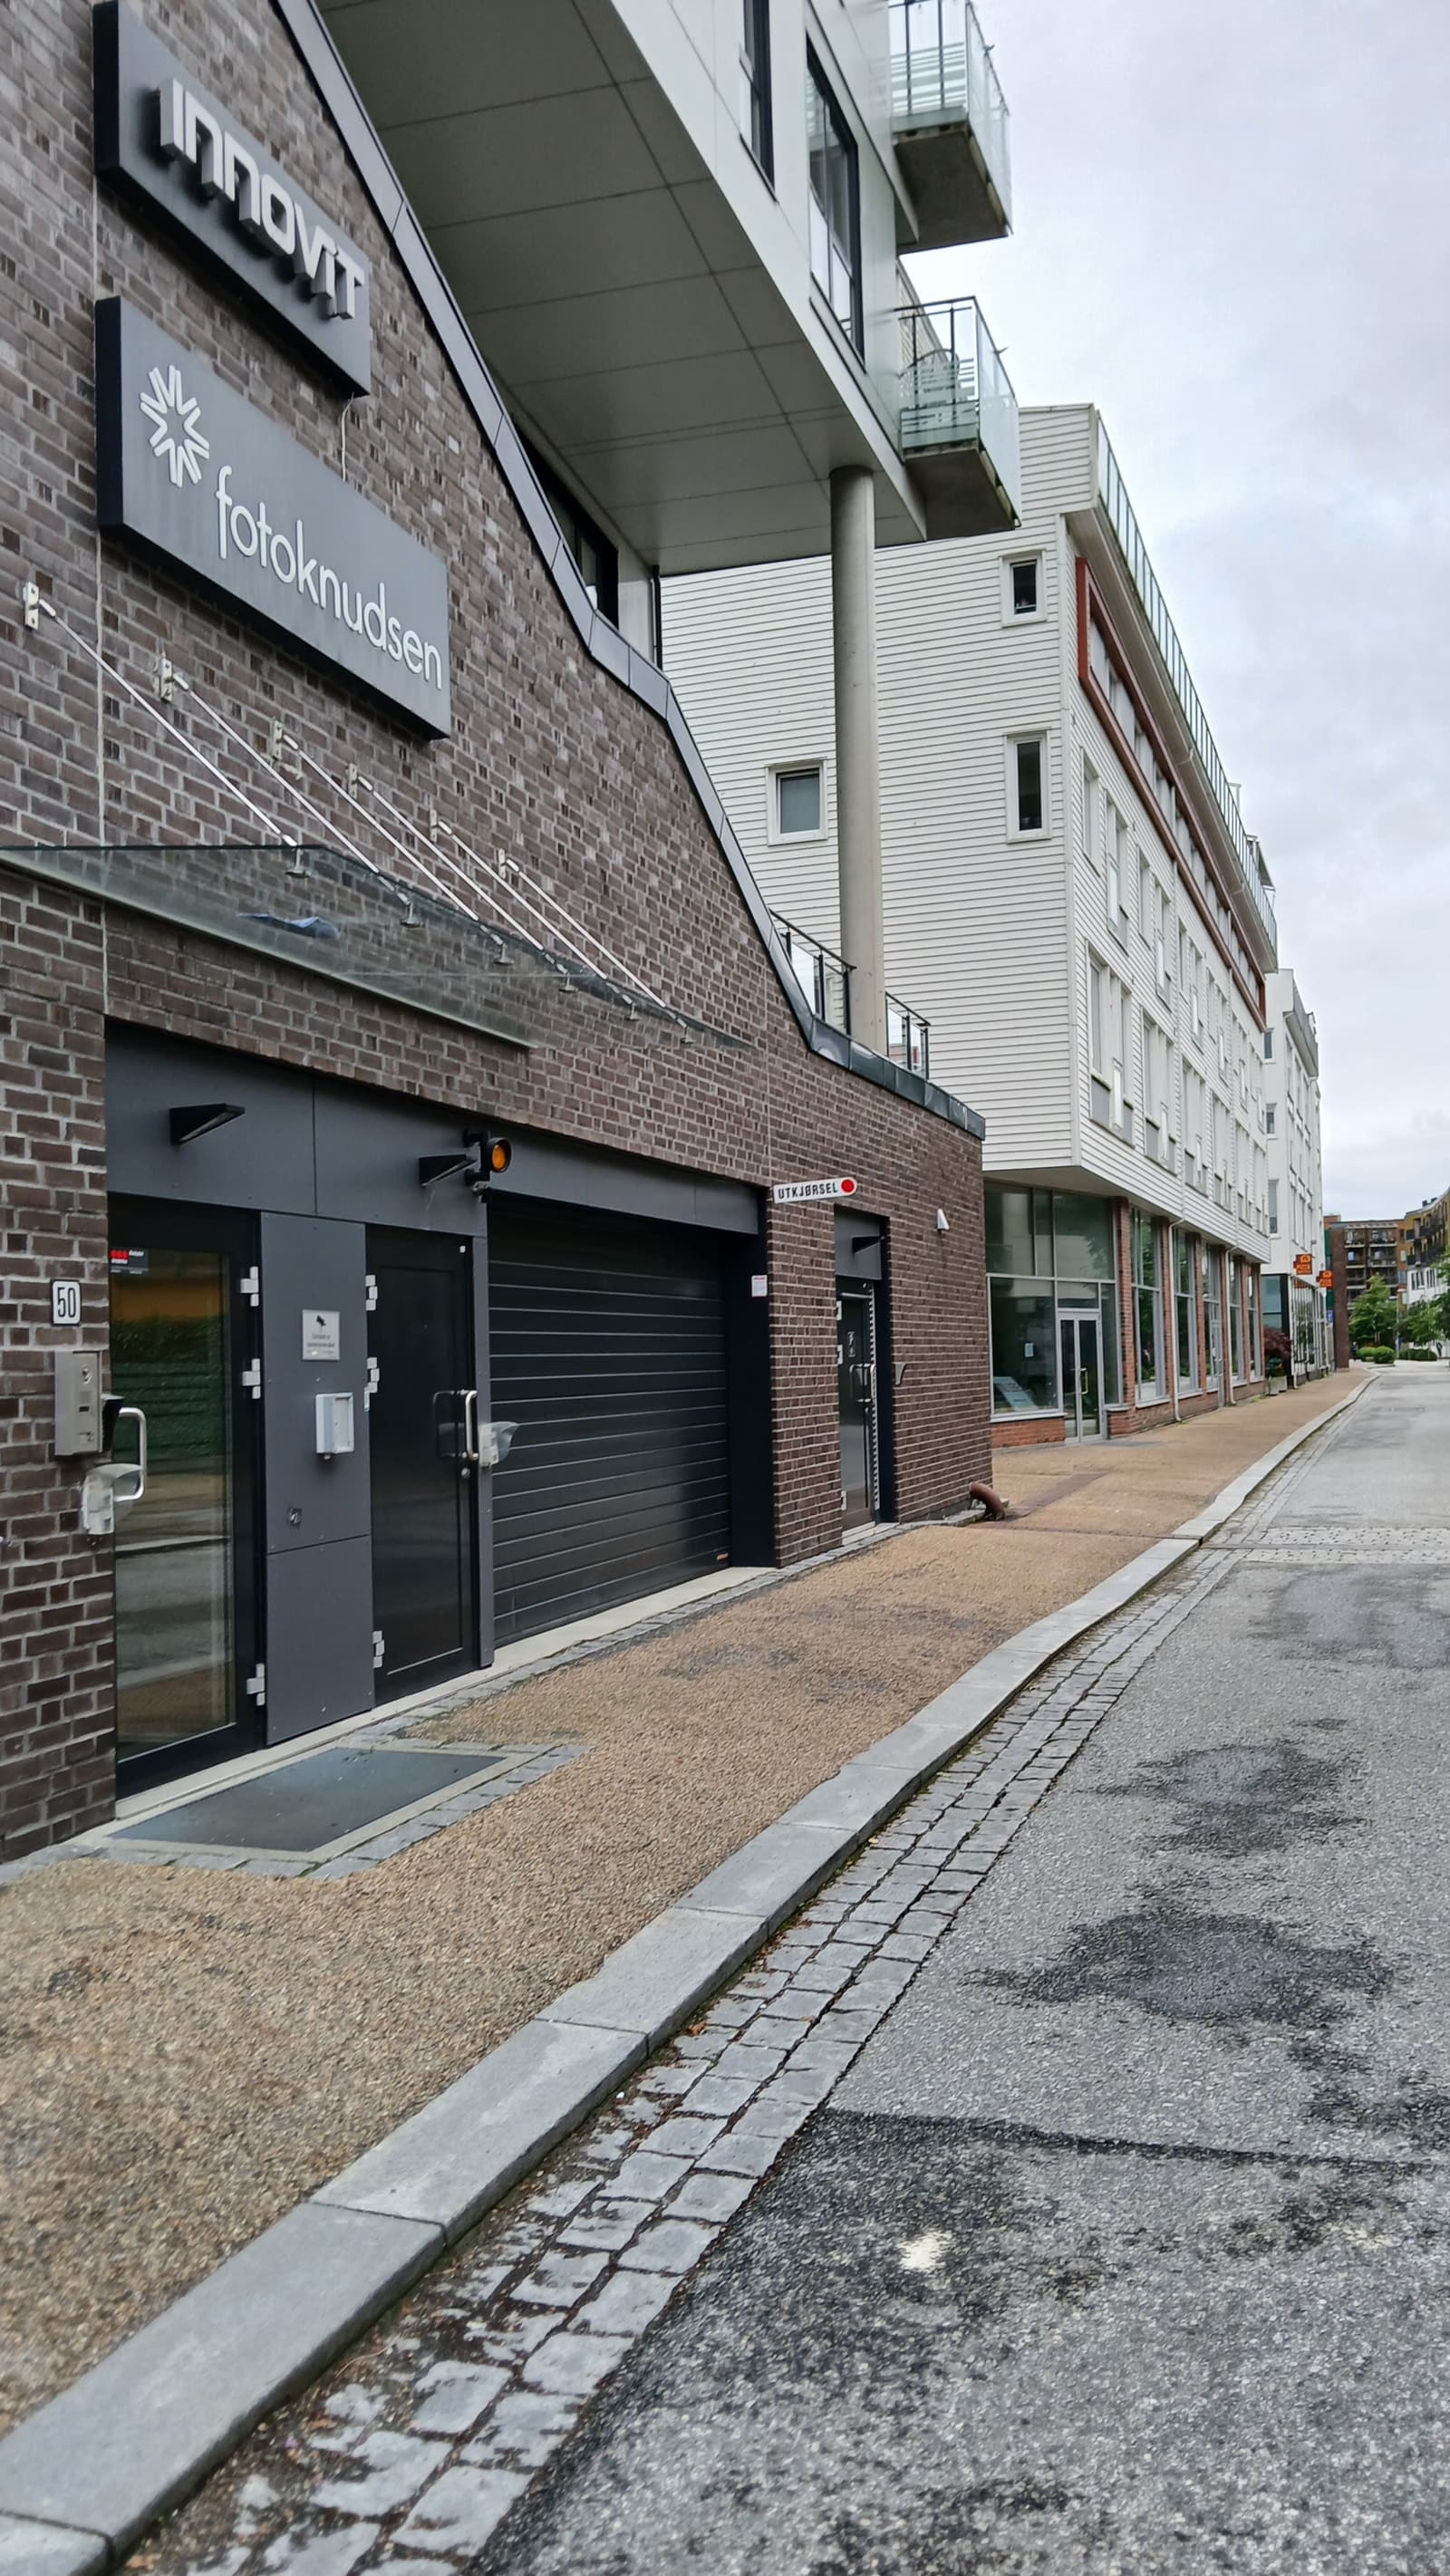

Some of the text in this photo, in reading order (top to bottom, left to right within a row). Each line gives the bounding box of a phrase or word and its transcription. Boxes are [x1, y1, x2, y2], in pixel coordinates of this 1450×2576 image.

[216, 466, 443, 690] fotoknudsen
[778, 1182, 839, 1200] UTKJØRSEL
[57, 1287, 76, 1318] 50
